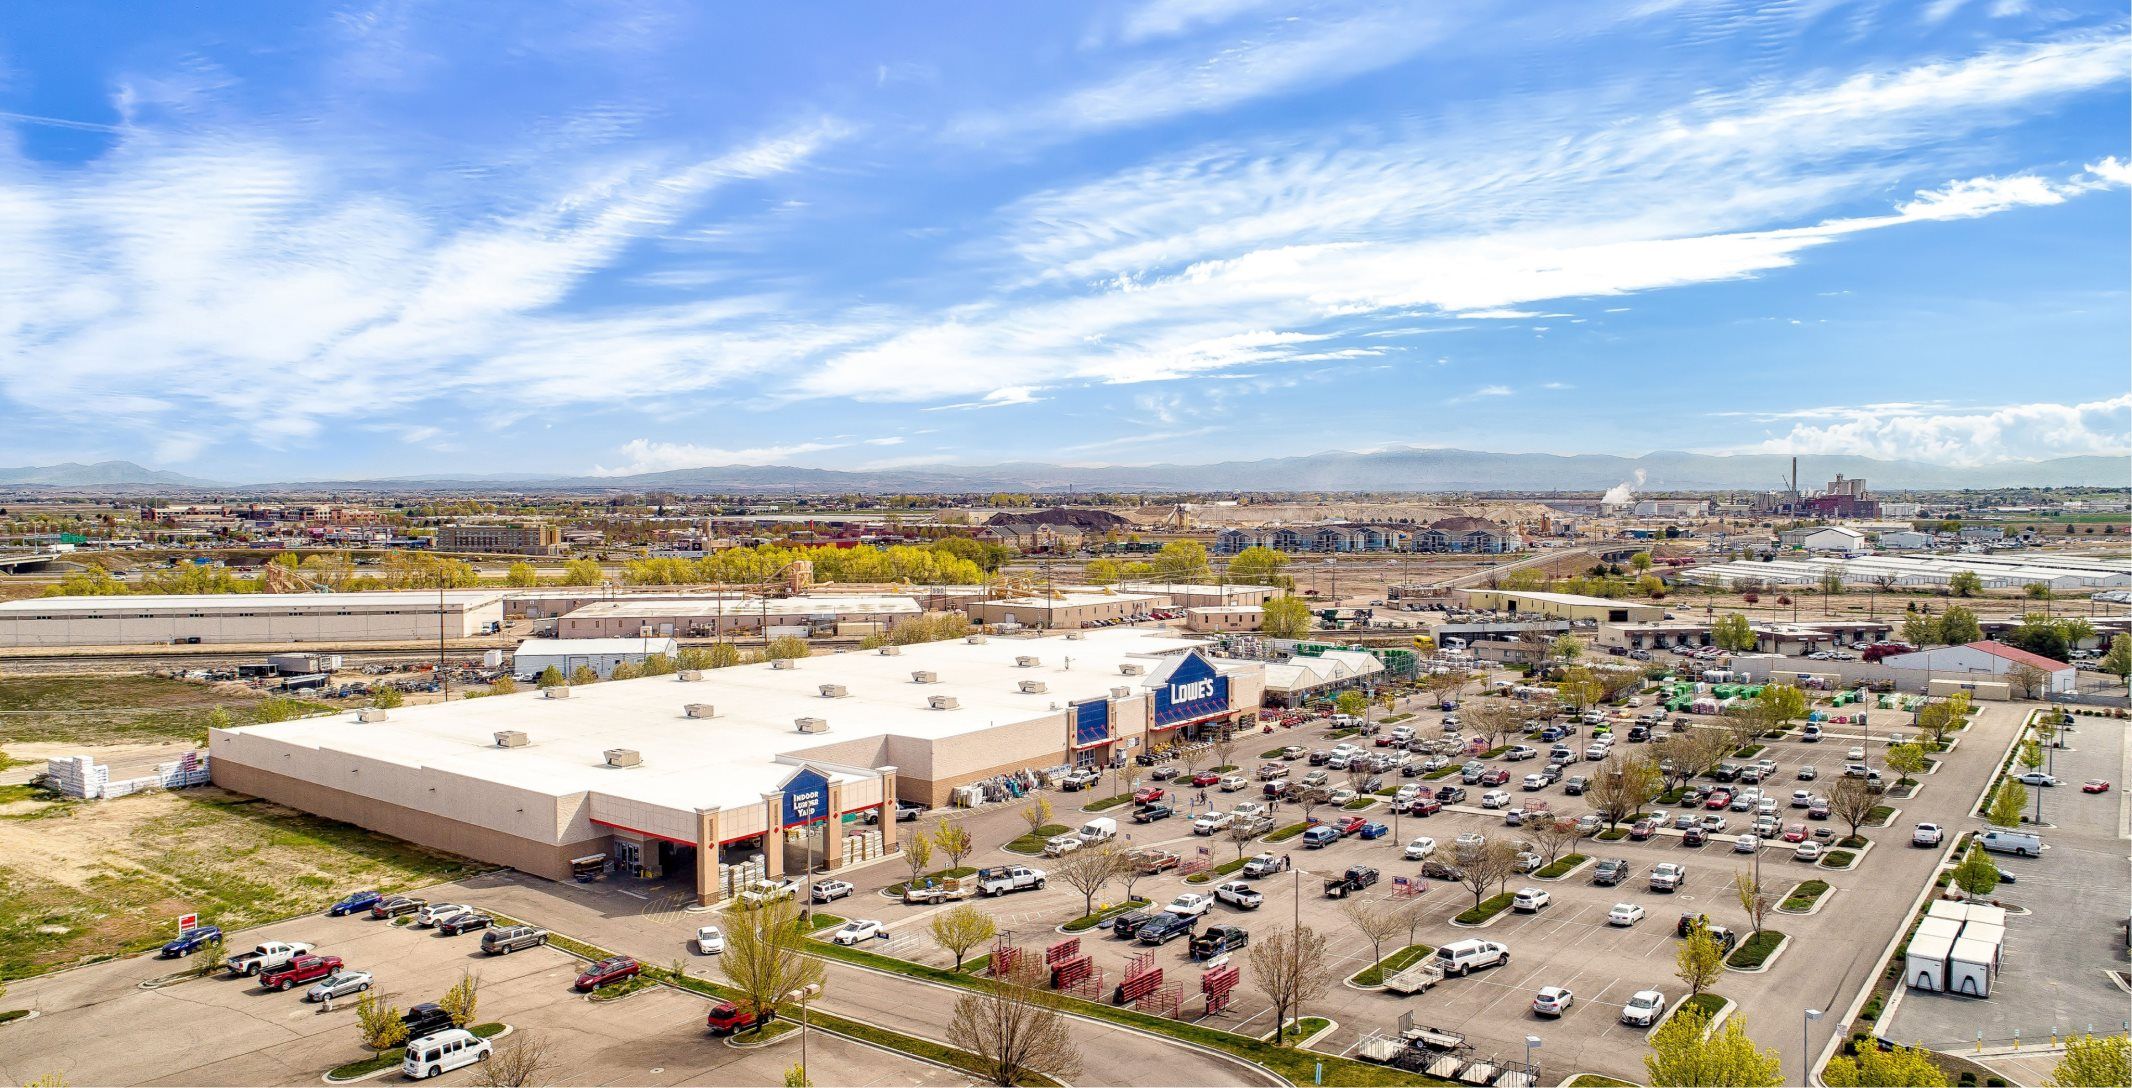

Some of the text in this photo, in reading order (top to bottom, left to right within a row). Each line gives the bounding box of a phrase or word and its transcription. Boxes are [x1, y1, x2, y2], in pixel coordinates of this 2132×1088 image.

[1170, 677, 1214, 705] LOWE'S
[793, 791, 818, 801] INDOOR
[793, 798, 818, 809] LUMER
